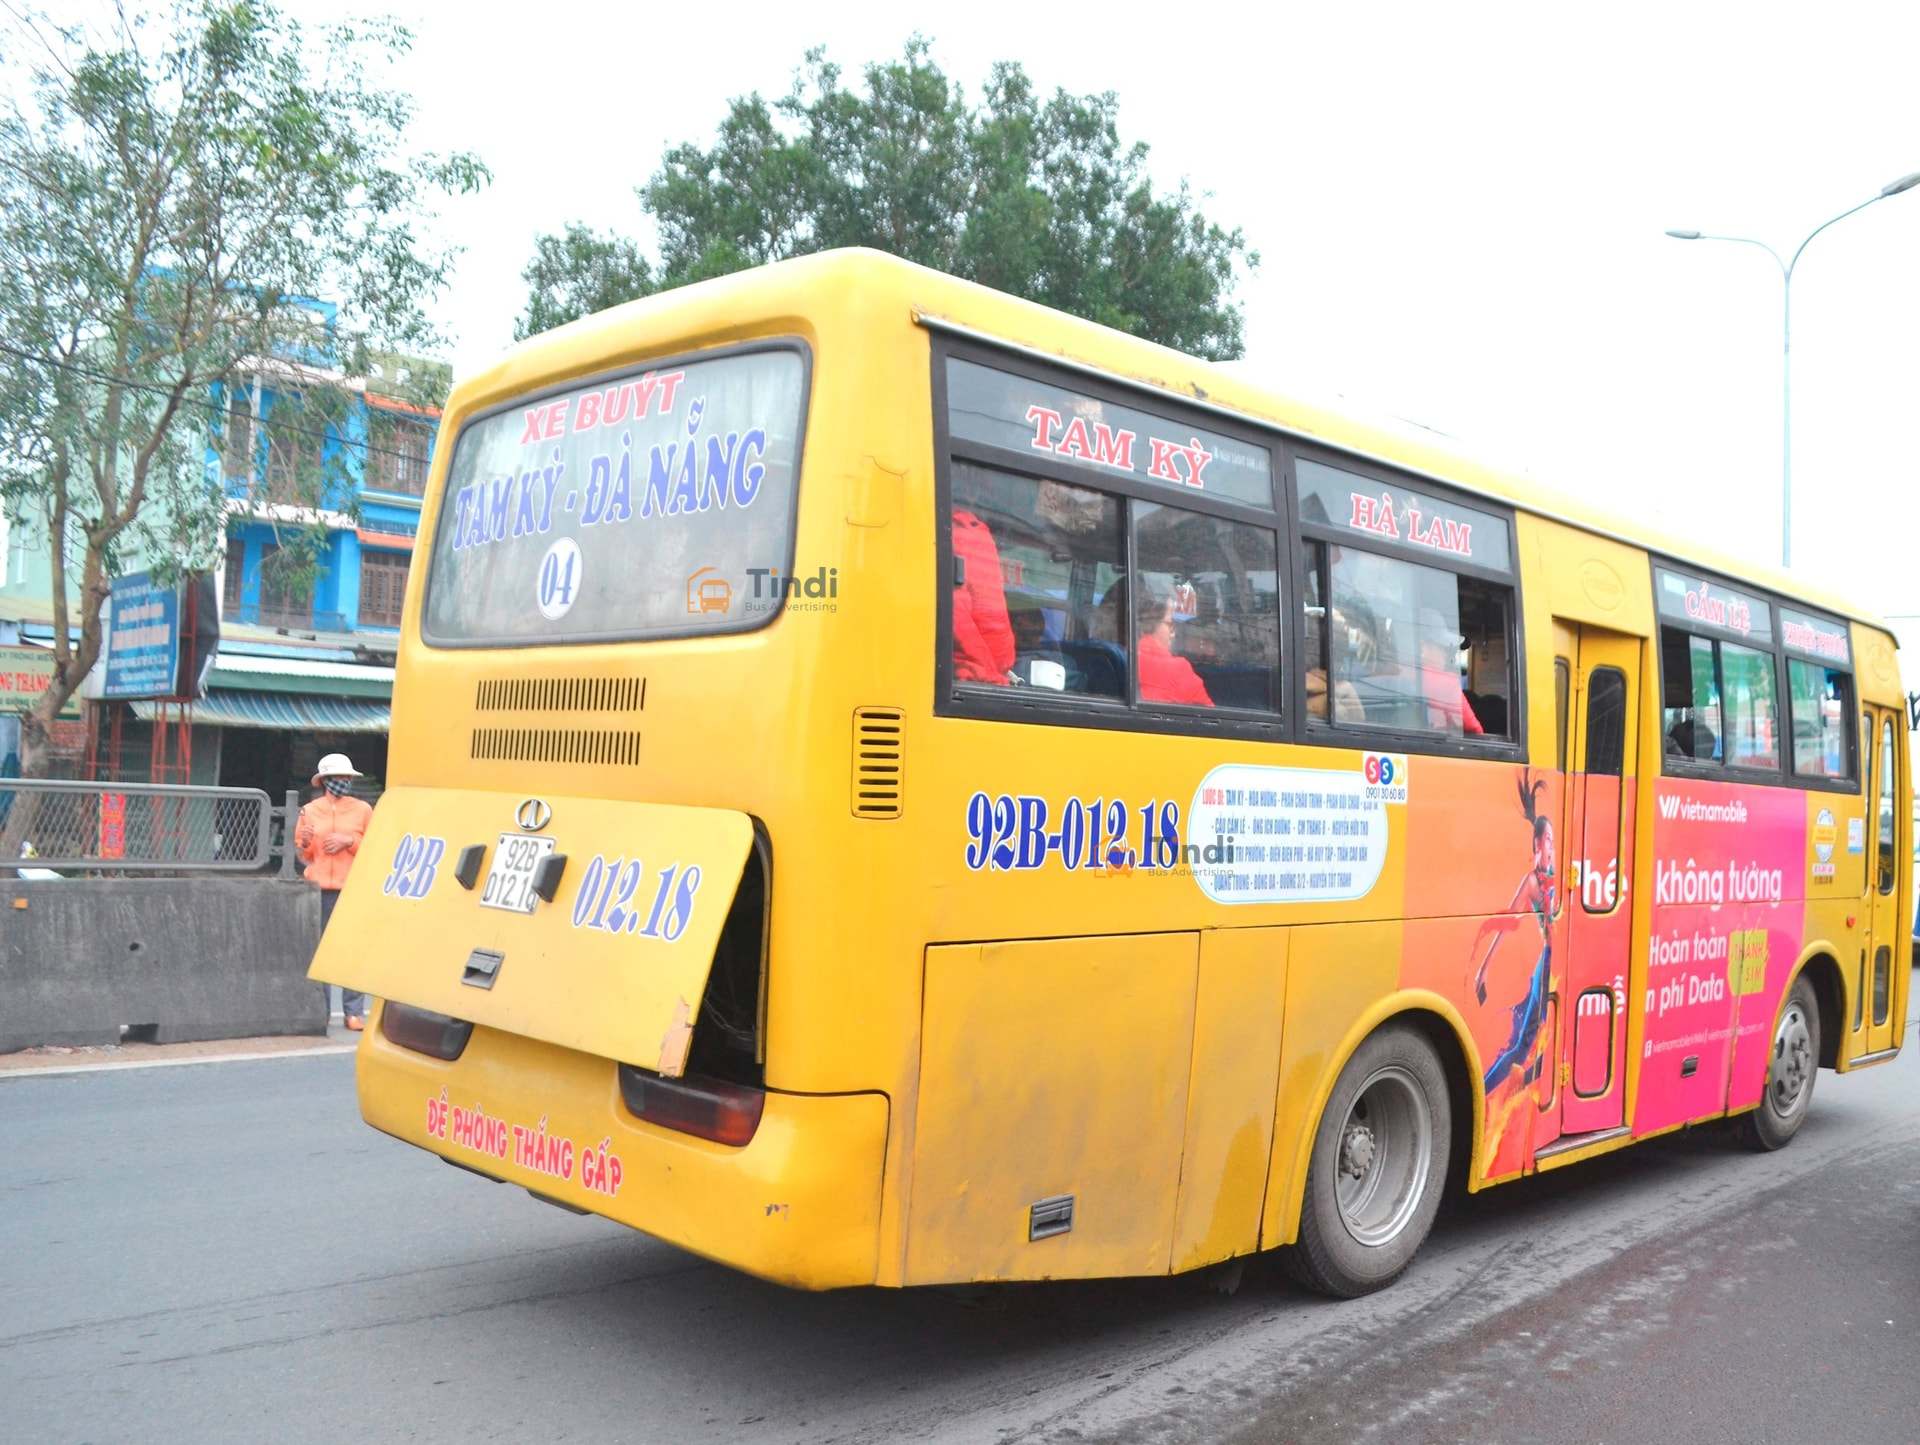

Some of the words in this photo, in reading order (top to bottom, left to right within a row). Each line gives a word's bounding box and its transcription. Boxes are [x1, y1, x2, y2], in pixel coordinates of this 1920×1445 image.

[520, 401, 569, 445] XE
[573, 370, 686, 434] BUÝT
[453, 474, 515, 551] TAM
[512, 446, 565, 538] KỲ
[580, 432, 632, 527] ĐÀ
[641, 396, 767, 519] NẴNG
[1025, 405, 1136, 471] TAM
[1146, 437, 1213, 488] KỲ
[1348, 492, 1399, 538] HÀ
[1406, 509, 1473, 556] LAM
[541, 550, 573, 607] 04
[966, 791, 1180, 871] 92B-012.18
[1680, 797, 1748, 823] vietnamobile
[383, 833, 445, 898] 92B
[572, 855, 702, 942] 012.18
[504, 838, 539, 873] 92B
[1656, 858, 1724, 912] không
[1729, 860, 1782, 909] tưởng
[1648, 929, 1689, 967] Hoàn
[1693, 926, 1727, 961] toàn
[1658, 972, 1687, 1018] phí
[1688, 972, 1725, 1006] Data
[427, 1086, 449, 1138] ĐỀ
[452, 1102, 508, 1159] PHÒNG
[513, 1114, 573, 1180] THẮNG
[581, 1135, 624, 1196] GẤP
